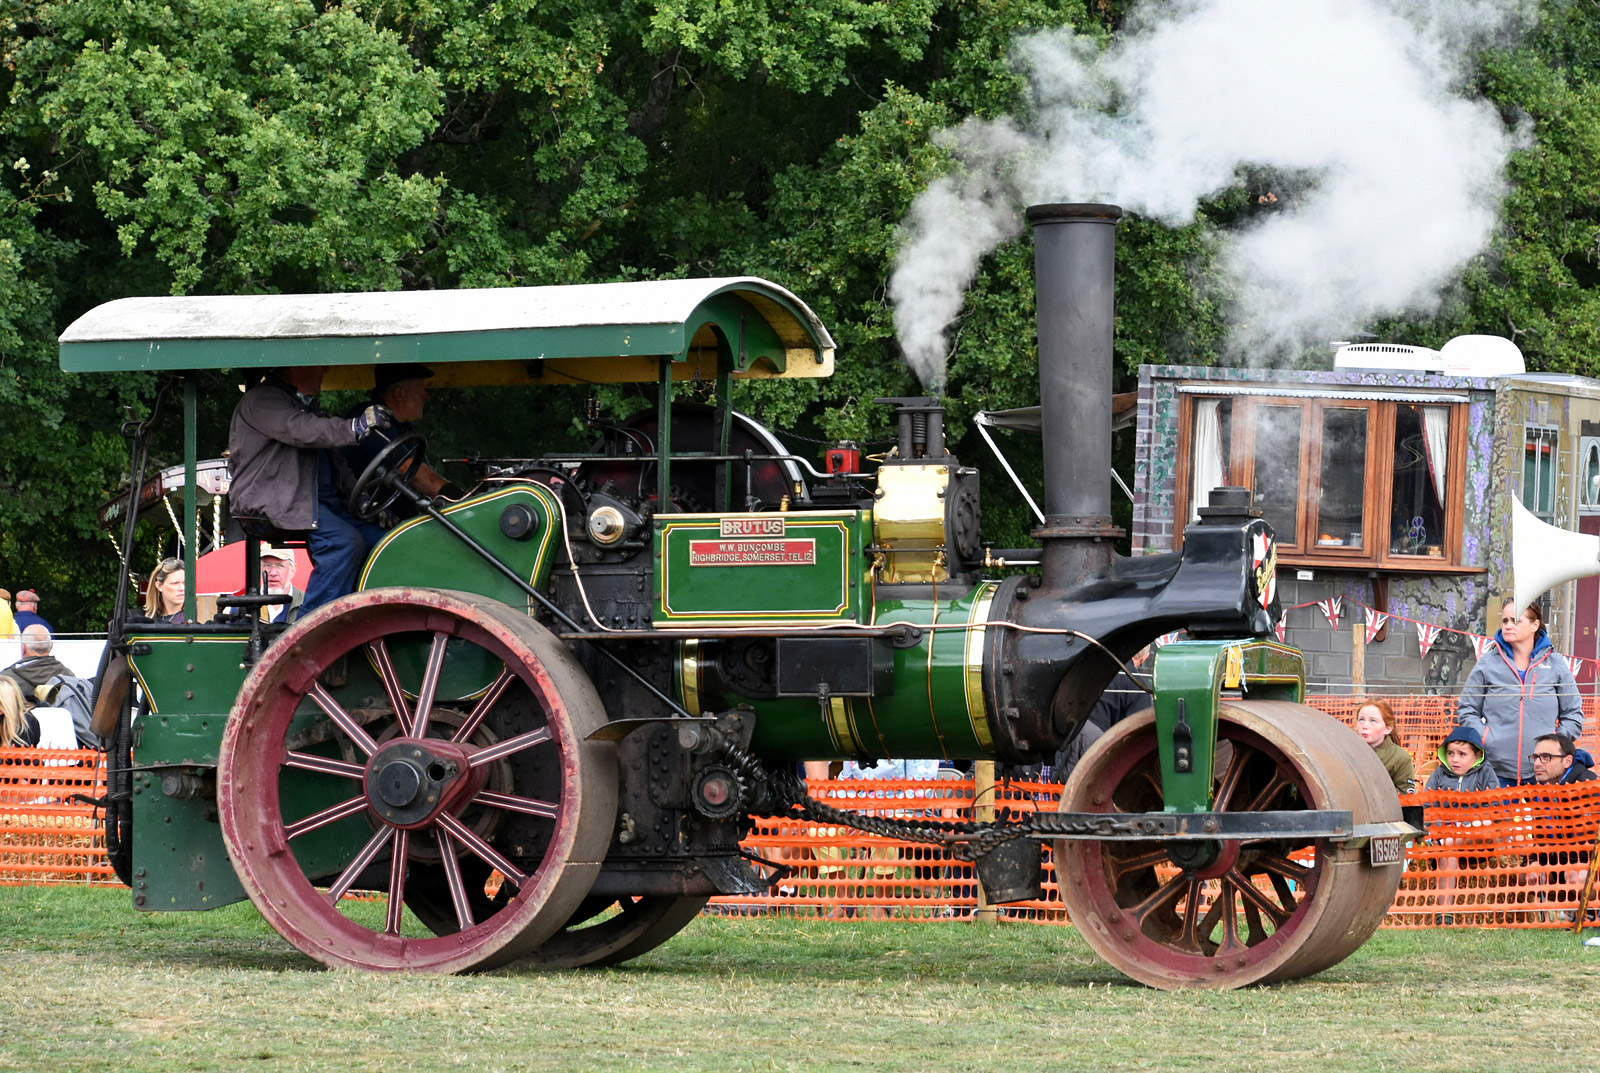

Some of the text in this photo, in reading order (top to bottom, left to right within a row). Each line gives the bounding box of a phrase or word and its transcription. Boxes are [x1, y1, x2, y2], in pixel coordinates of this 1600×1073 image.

[723, 521, 782, 534] BRUTUS
[719, 542, 785, 552] W.W. BUNCOMBE
